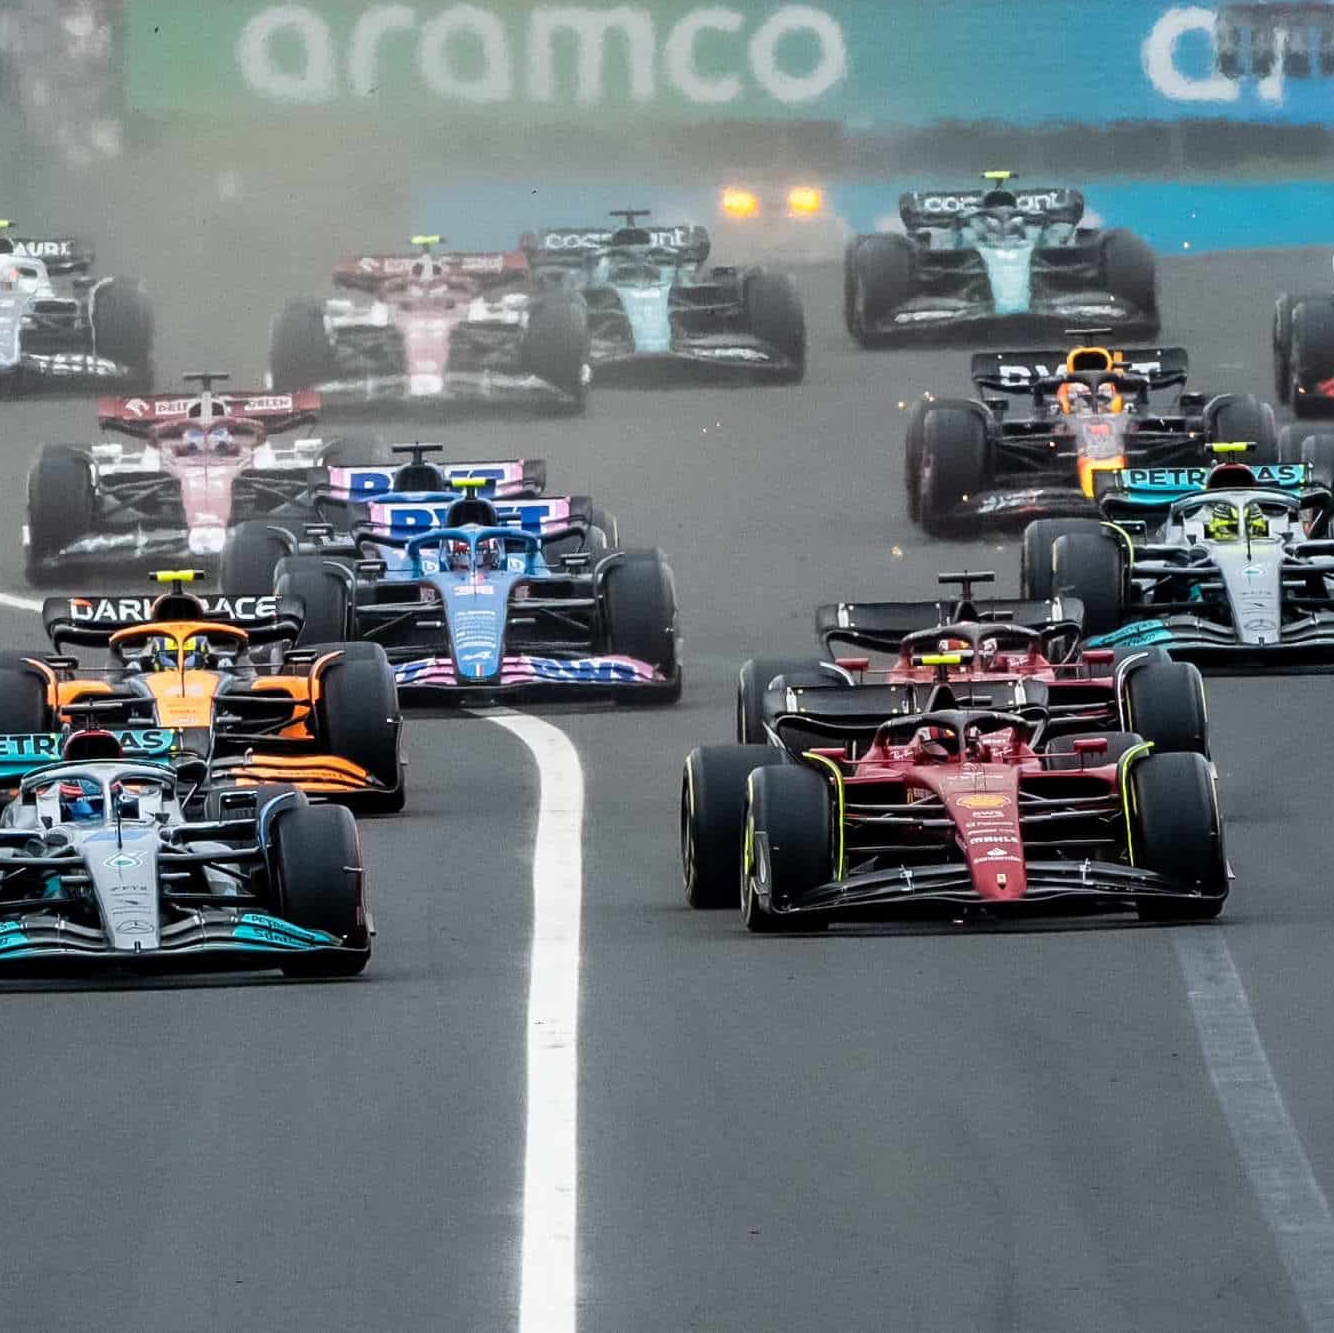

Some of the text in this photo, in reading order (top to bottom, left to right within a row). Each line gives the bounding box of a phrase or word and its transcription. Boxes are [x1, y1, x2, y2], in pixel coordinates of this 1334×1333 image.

[237, 3, 848, 104] aramco
[1129, 465, 1296, 486] PETRAS
[69, 596, 278, 621] DARACE
